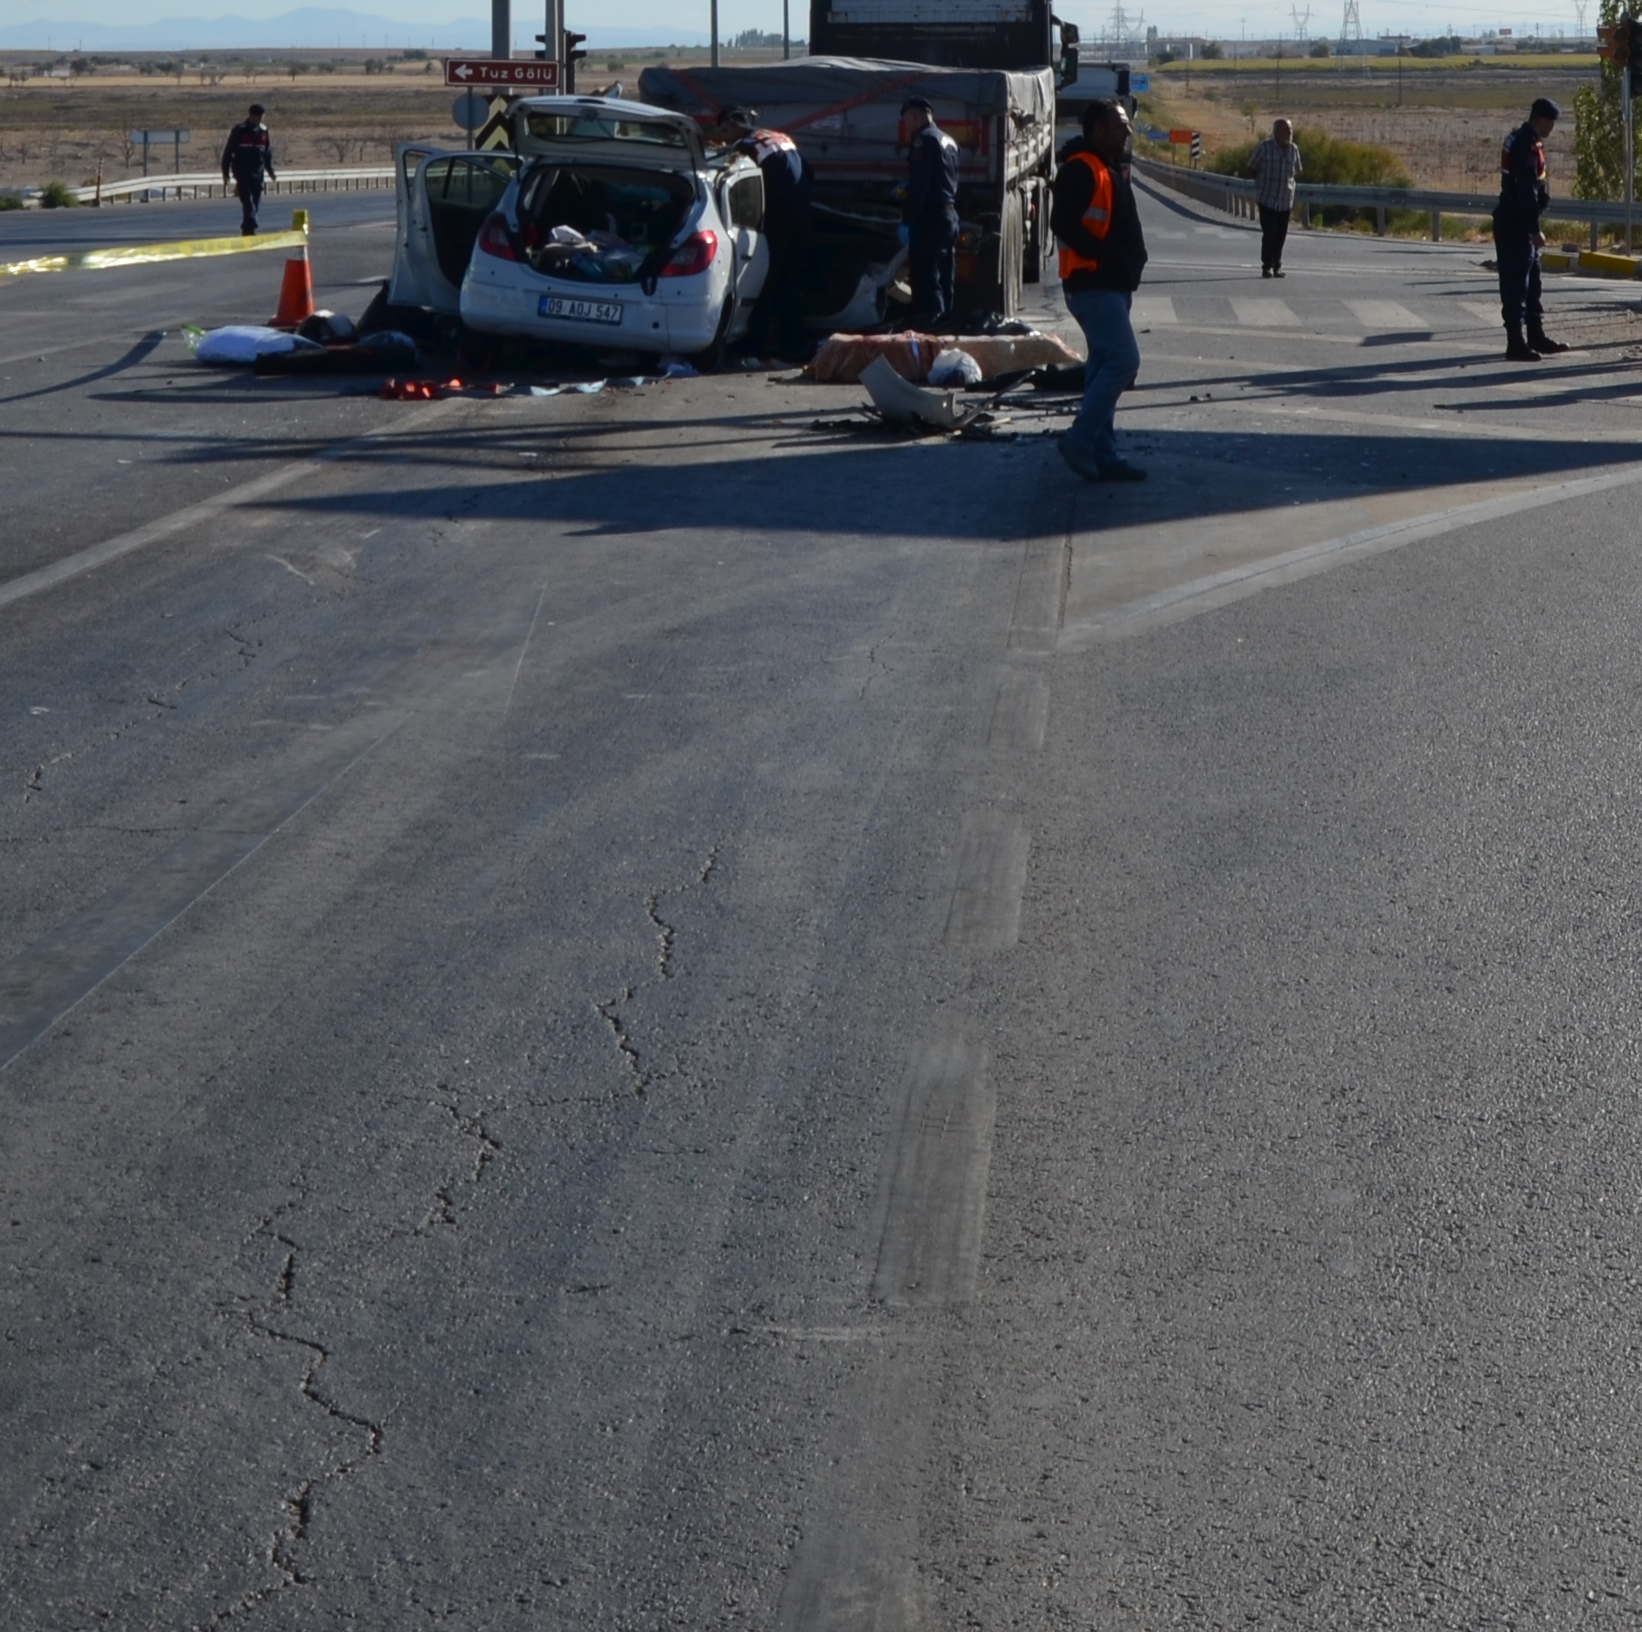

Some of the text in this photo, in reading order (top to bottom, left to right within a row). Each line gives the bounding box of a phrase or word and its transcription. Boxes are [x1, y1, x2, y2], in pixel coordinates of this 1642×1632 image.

[479, 67, 552, 80] Tuz Gölü
[548, 299, 563, 313] 09
[596, 305, 619, 319] 547
